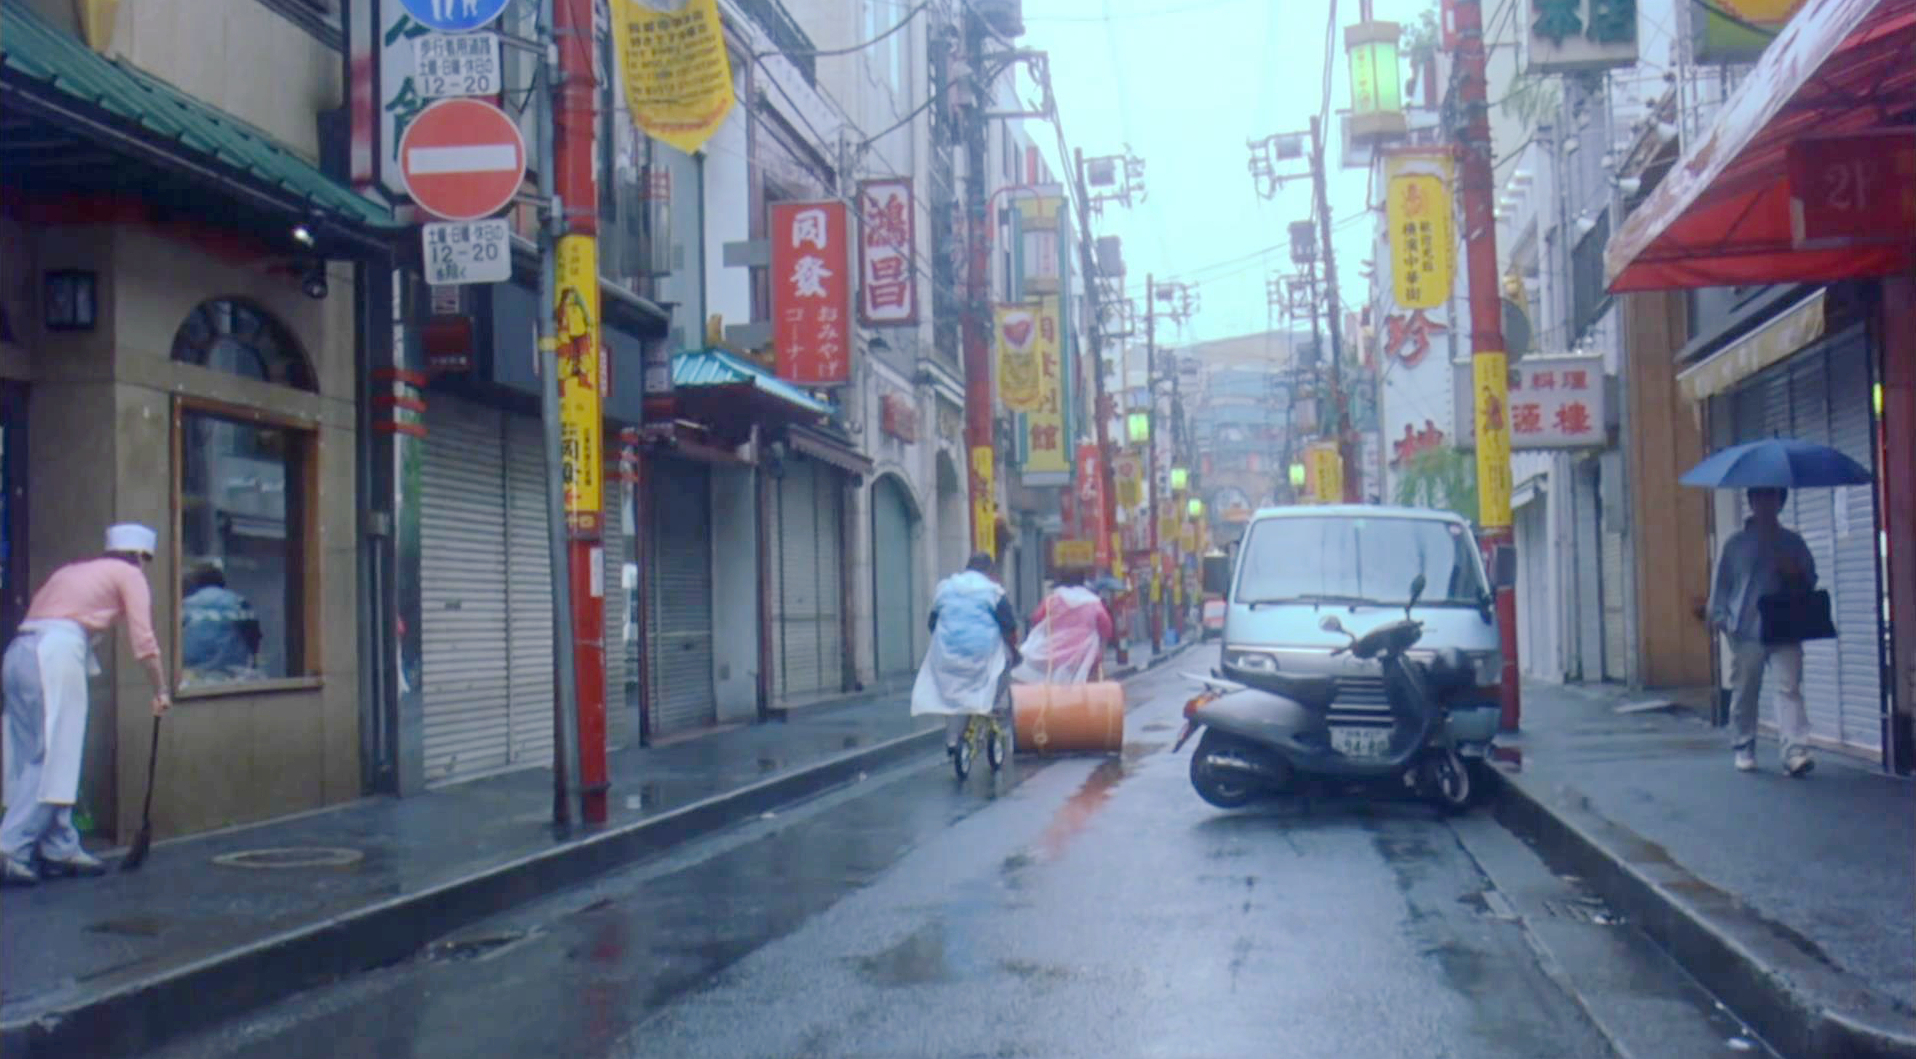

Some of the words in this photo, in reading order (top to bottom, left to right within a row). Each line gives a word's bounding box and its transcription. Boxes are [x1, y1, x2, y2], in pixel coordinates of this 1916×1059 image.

[784, 307, 805, 381] コーナー
[817, 305, 841, 379] おみやげ
